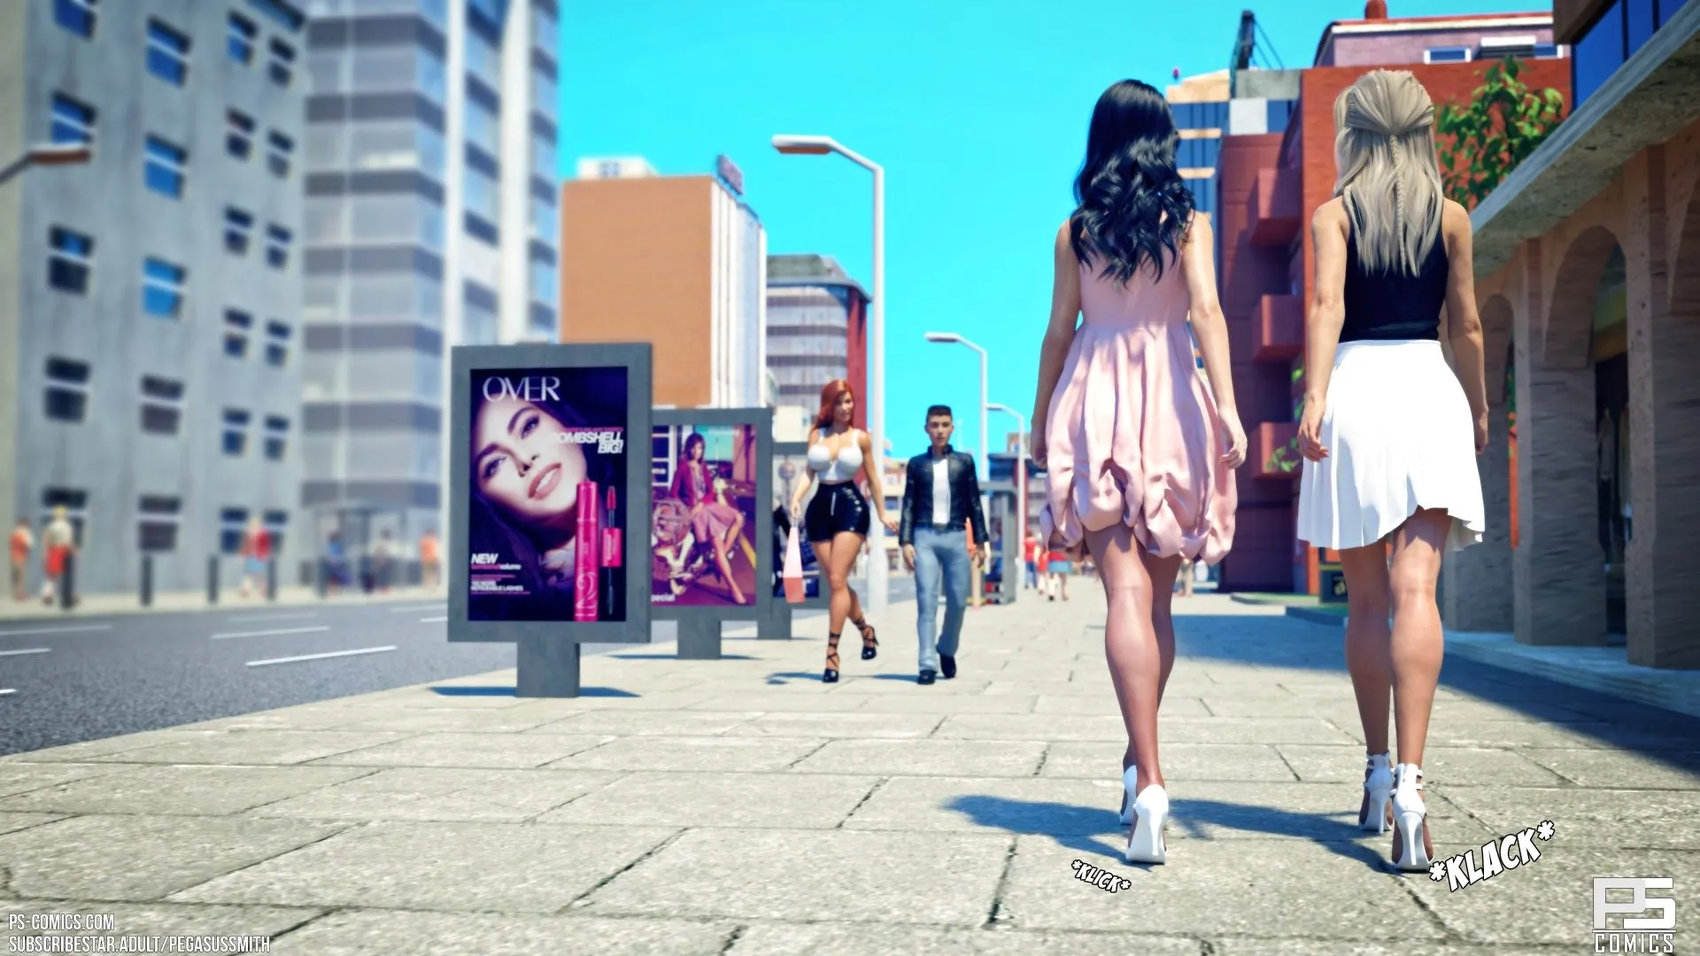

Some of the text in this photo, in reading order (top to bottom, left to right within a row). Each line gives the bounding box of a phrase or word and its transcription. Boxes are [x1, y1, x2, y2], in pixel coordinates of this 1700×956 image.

[482, 376, 561, 402] OVER
[553, 431, 622, 444] OMBSHELL
[597, 439, 624, 454] BIG!
[471, 553, 499, 564] NEW
[651, 592, 676, 602] pecial
